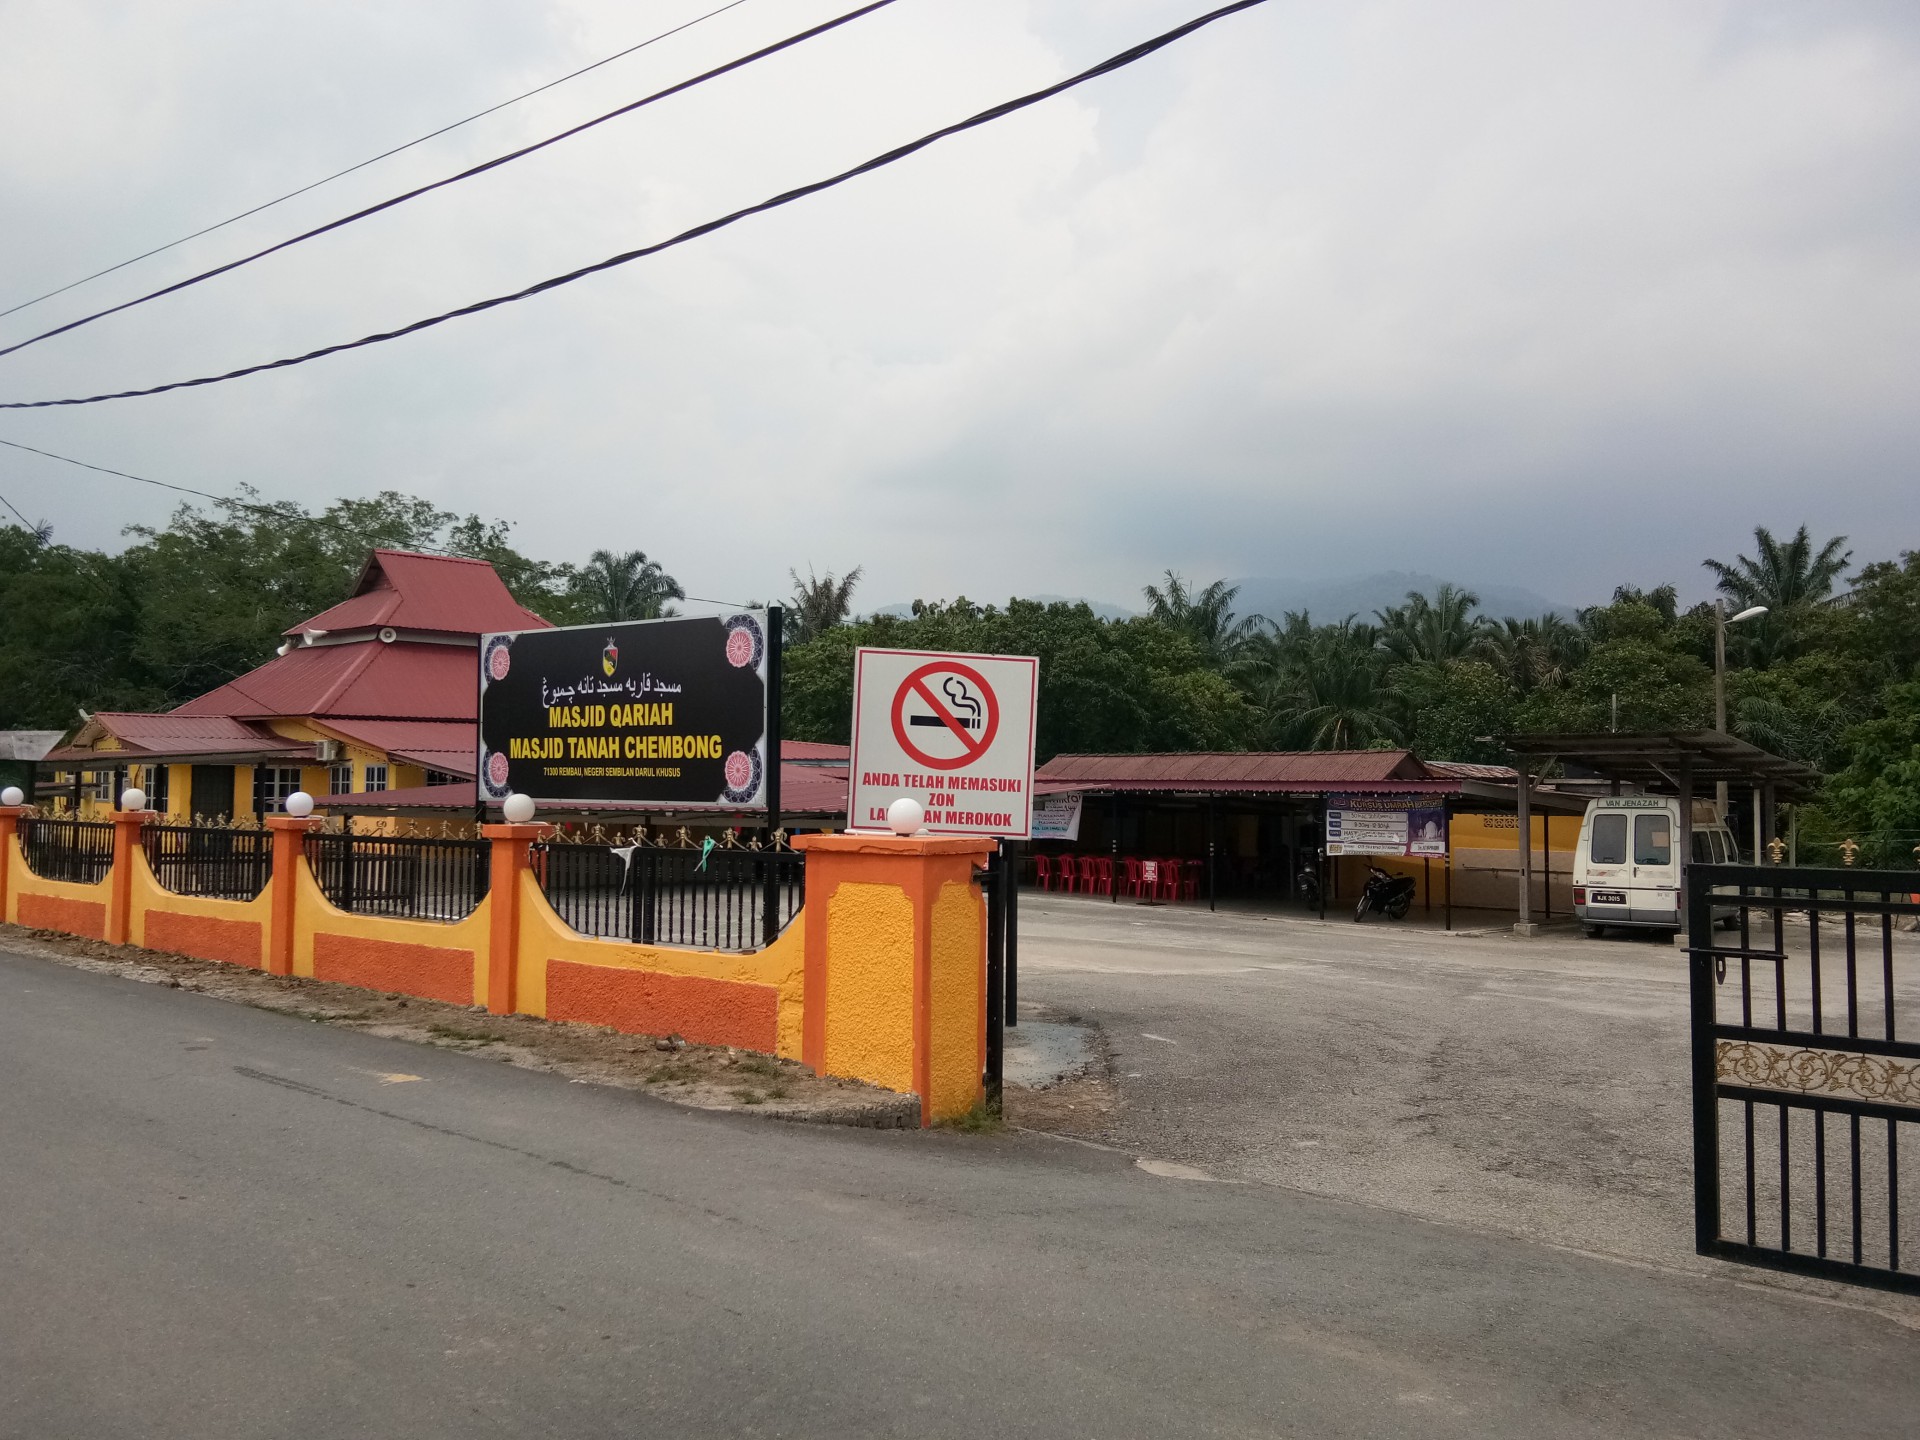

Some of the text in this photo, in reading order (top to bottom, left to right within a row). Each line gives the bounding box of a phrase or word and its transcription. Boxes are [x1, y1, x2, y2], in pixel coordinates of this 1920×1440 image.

[597, 680, 623, 698] مسجد
[654, 679, 682, 697] مسجد
[549, 703, 673, 728] MASJID QARIAH
[510, 735, 722, 759] MASJID TANAH CHEMBONG
[543, 767, 681, 778] 71300 REMBAU, NEGERI SEMBILAN DARUL KHUSUS
[862, 772, 1022, 793] ANDA TELAH MEMASUKI
[928, 793, 955, 807] ZON
[1350, 799, 1383, 809] KURSUS
[1384, 799, 1414, 809] UMRAH
[869, 807, 1012, 827] LAAN MEROKOK
